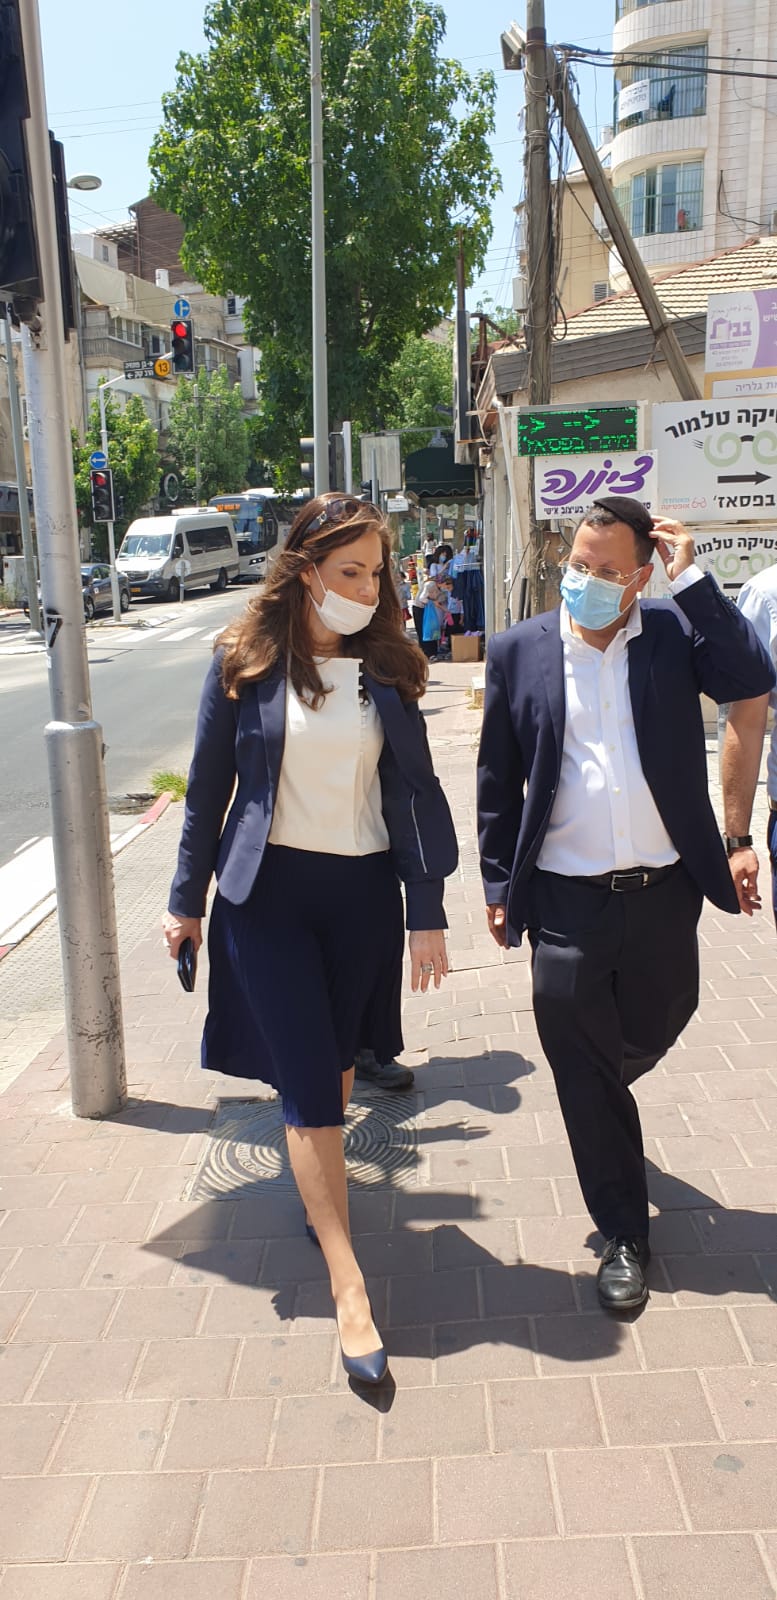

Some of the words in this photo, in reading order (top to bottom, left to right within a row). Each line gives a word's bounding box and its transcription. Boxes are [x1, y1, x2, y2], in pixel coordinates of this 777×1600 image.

[158, 362, 167, 373] 13
[735, 383, 762, 392] גלריה
[664, 410, 730, 438] טלמור
[737, 408, 777, 428] יקה
[713, 494, 776, 508] בפסאז'
[561, 506, 584, 515] בעיצוב
